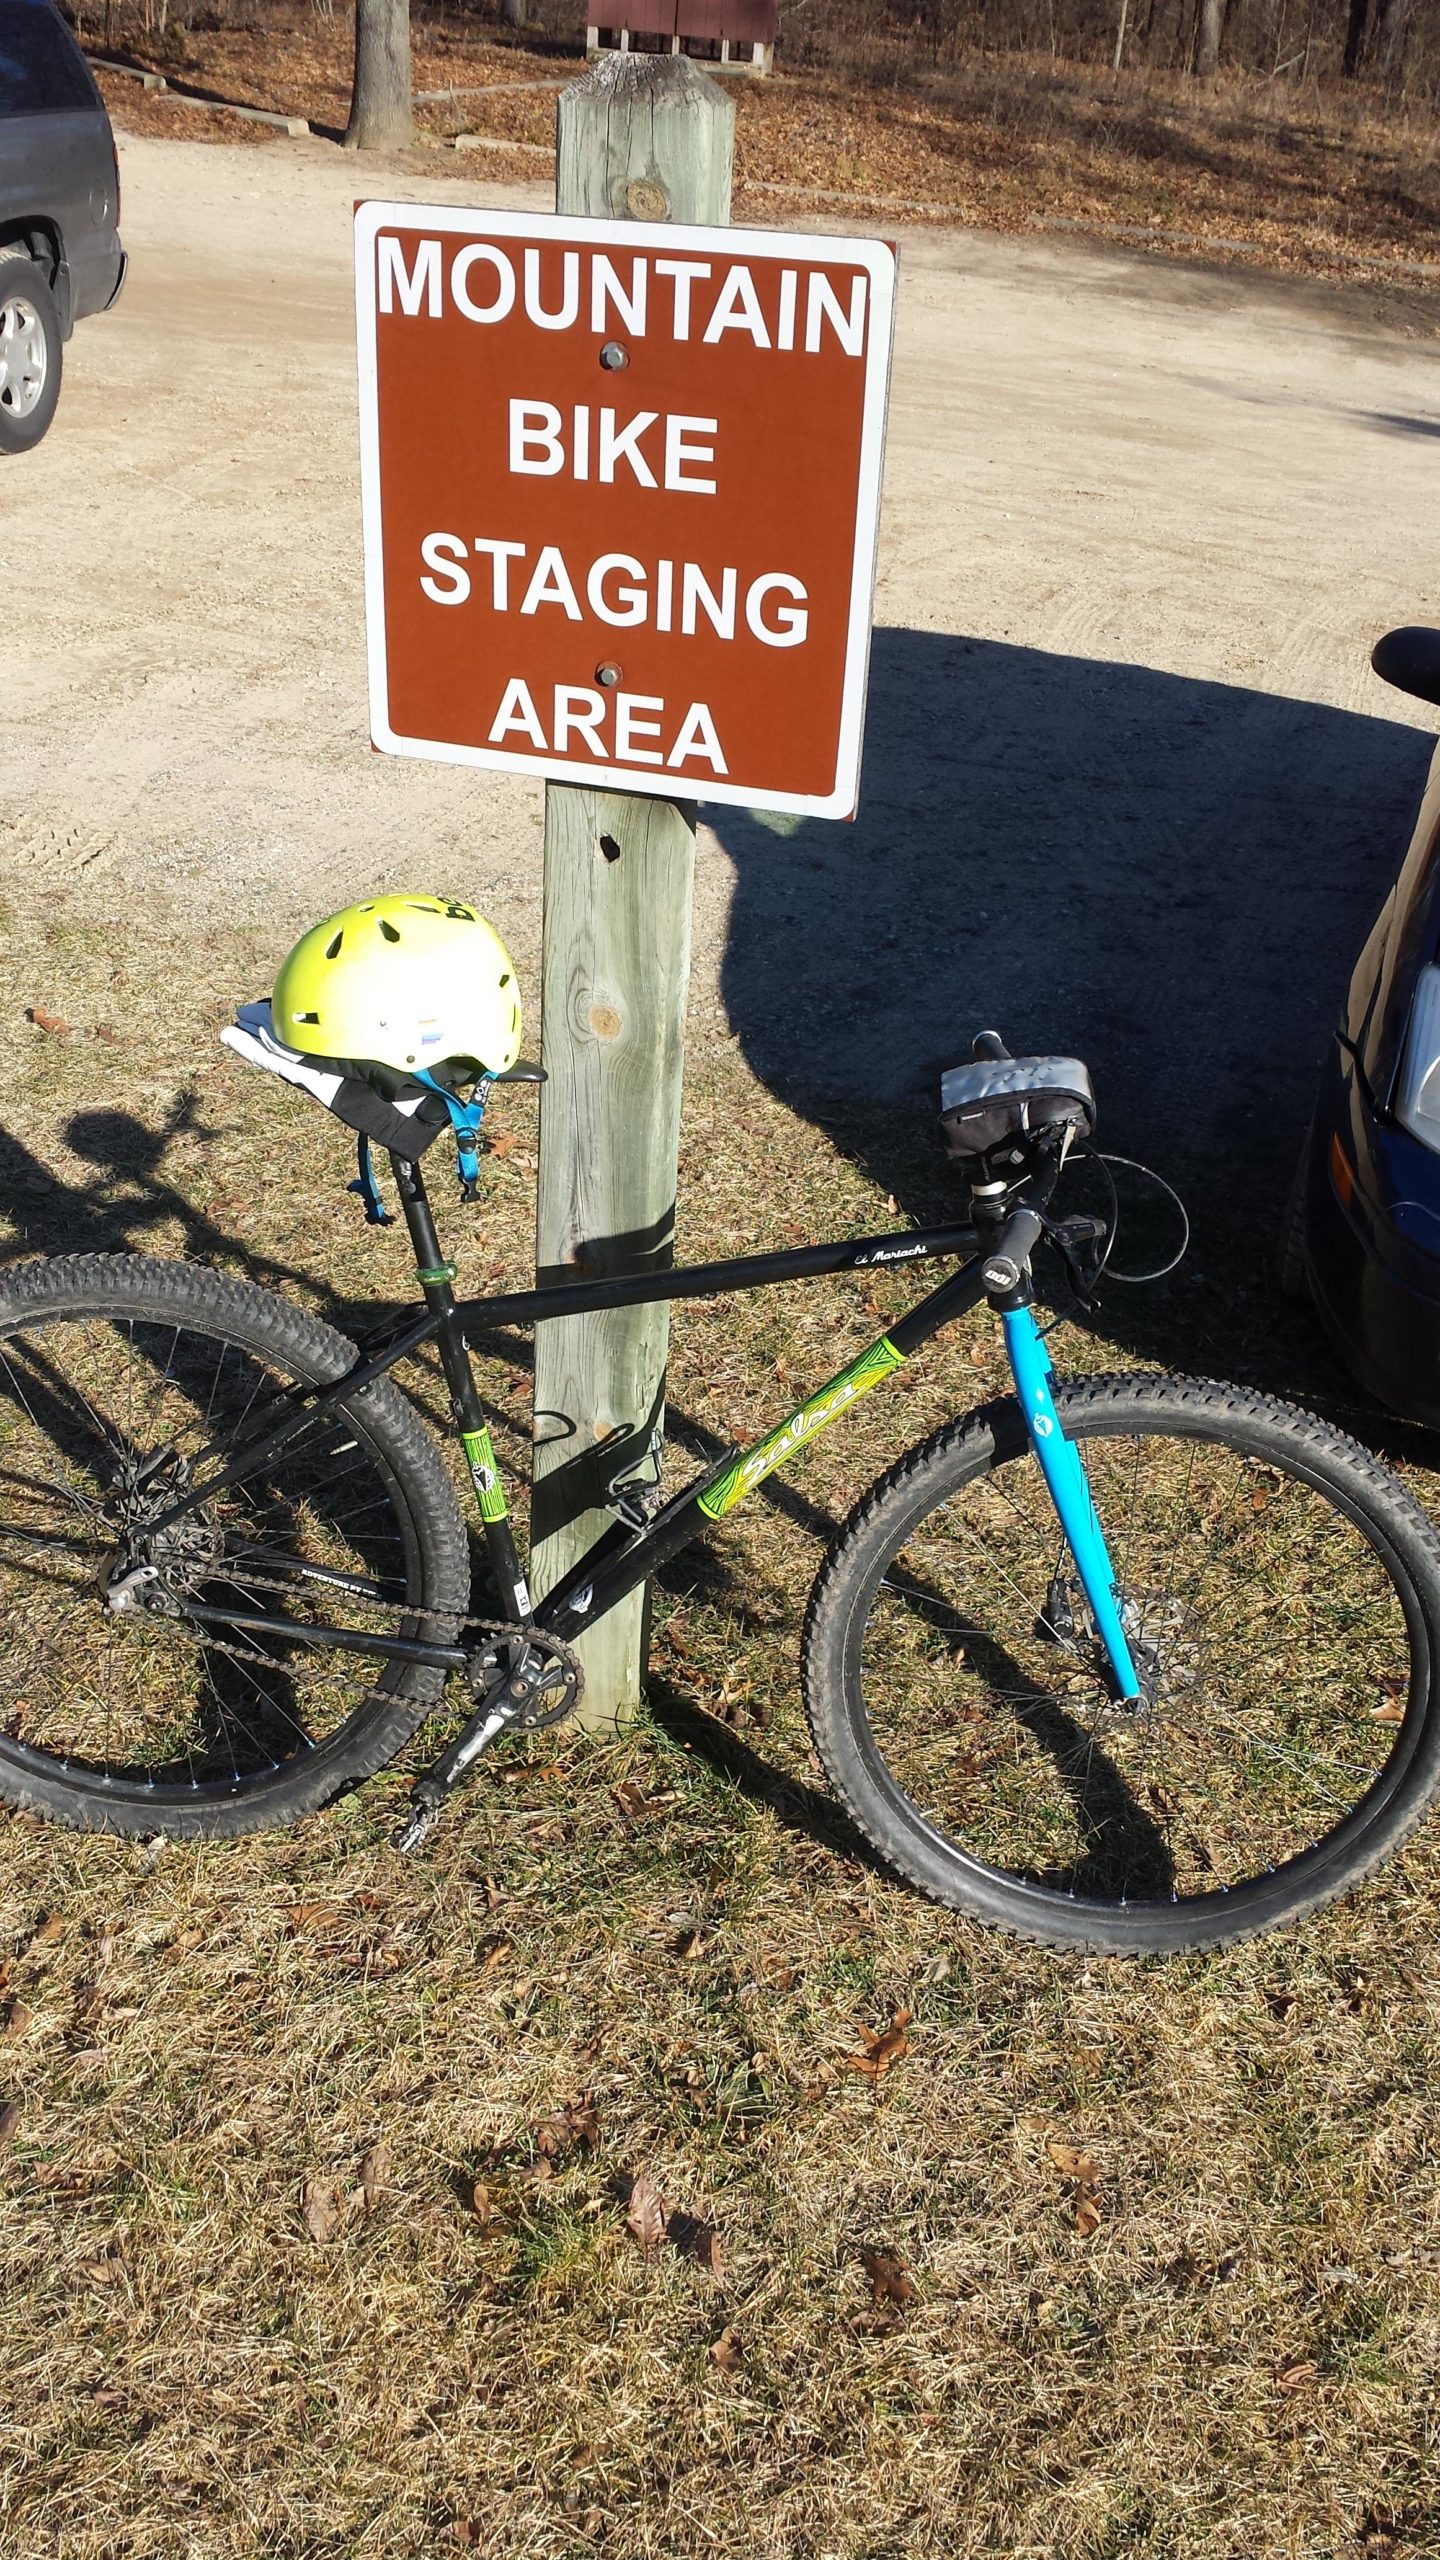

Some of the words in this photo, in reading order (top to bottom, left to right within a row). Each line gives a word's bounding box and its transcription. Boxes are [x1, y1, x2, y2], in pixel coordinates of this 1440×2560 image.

[377, 236, 868, 357] MOUNTAIN
[509, 398, 719, 495] BIKE
[419, 532, 810, 648] STAGING
[487, 678, 729, 775] AREA
[854, 1253, 869, 1265] El
[871, 1244, 928, 1263] Mariachi
[742, 1383, 862, 1490] Salsa
